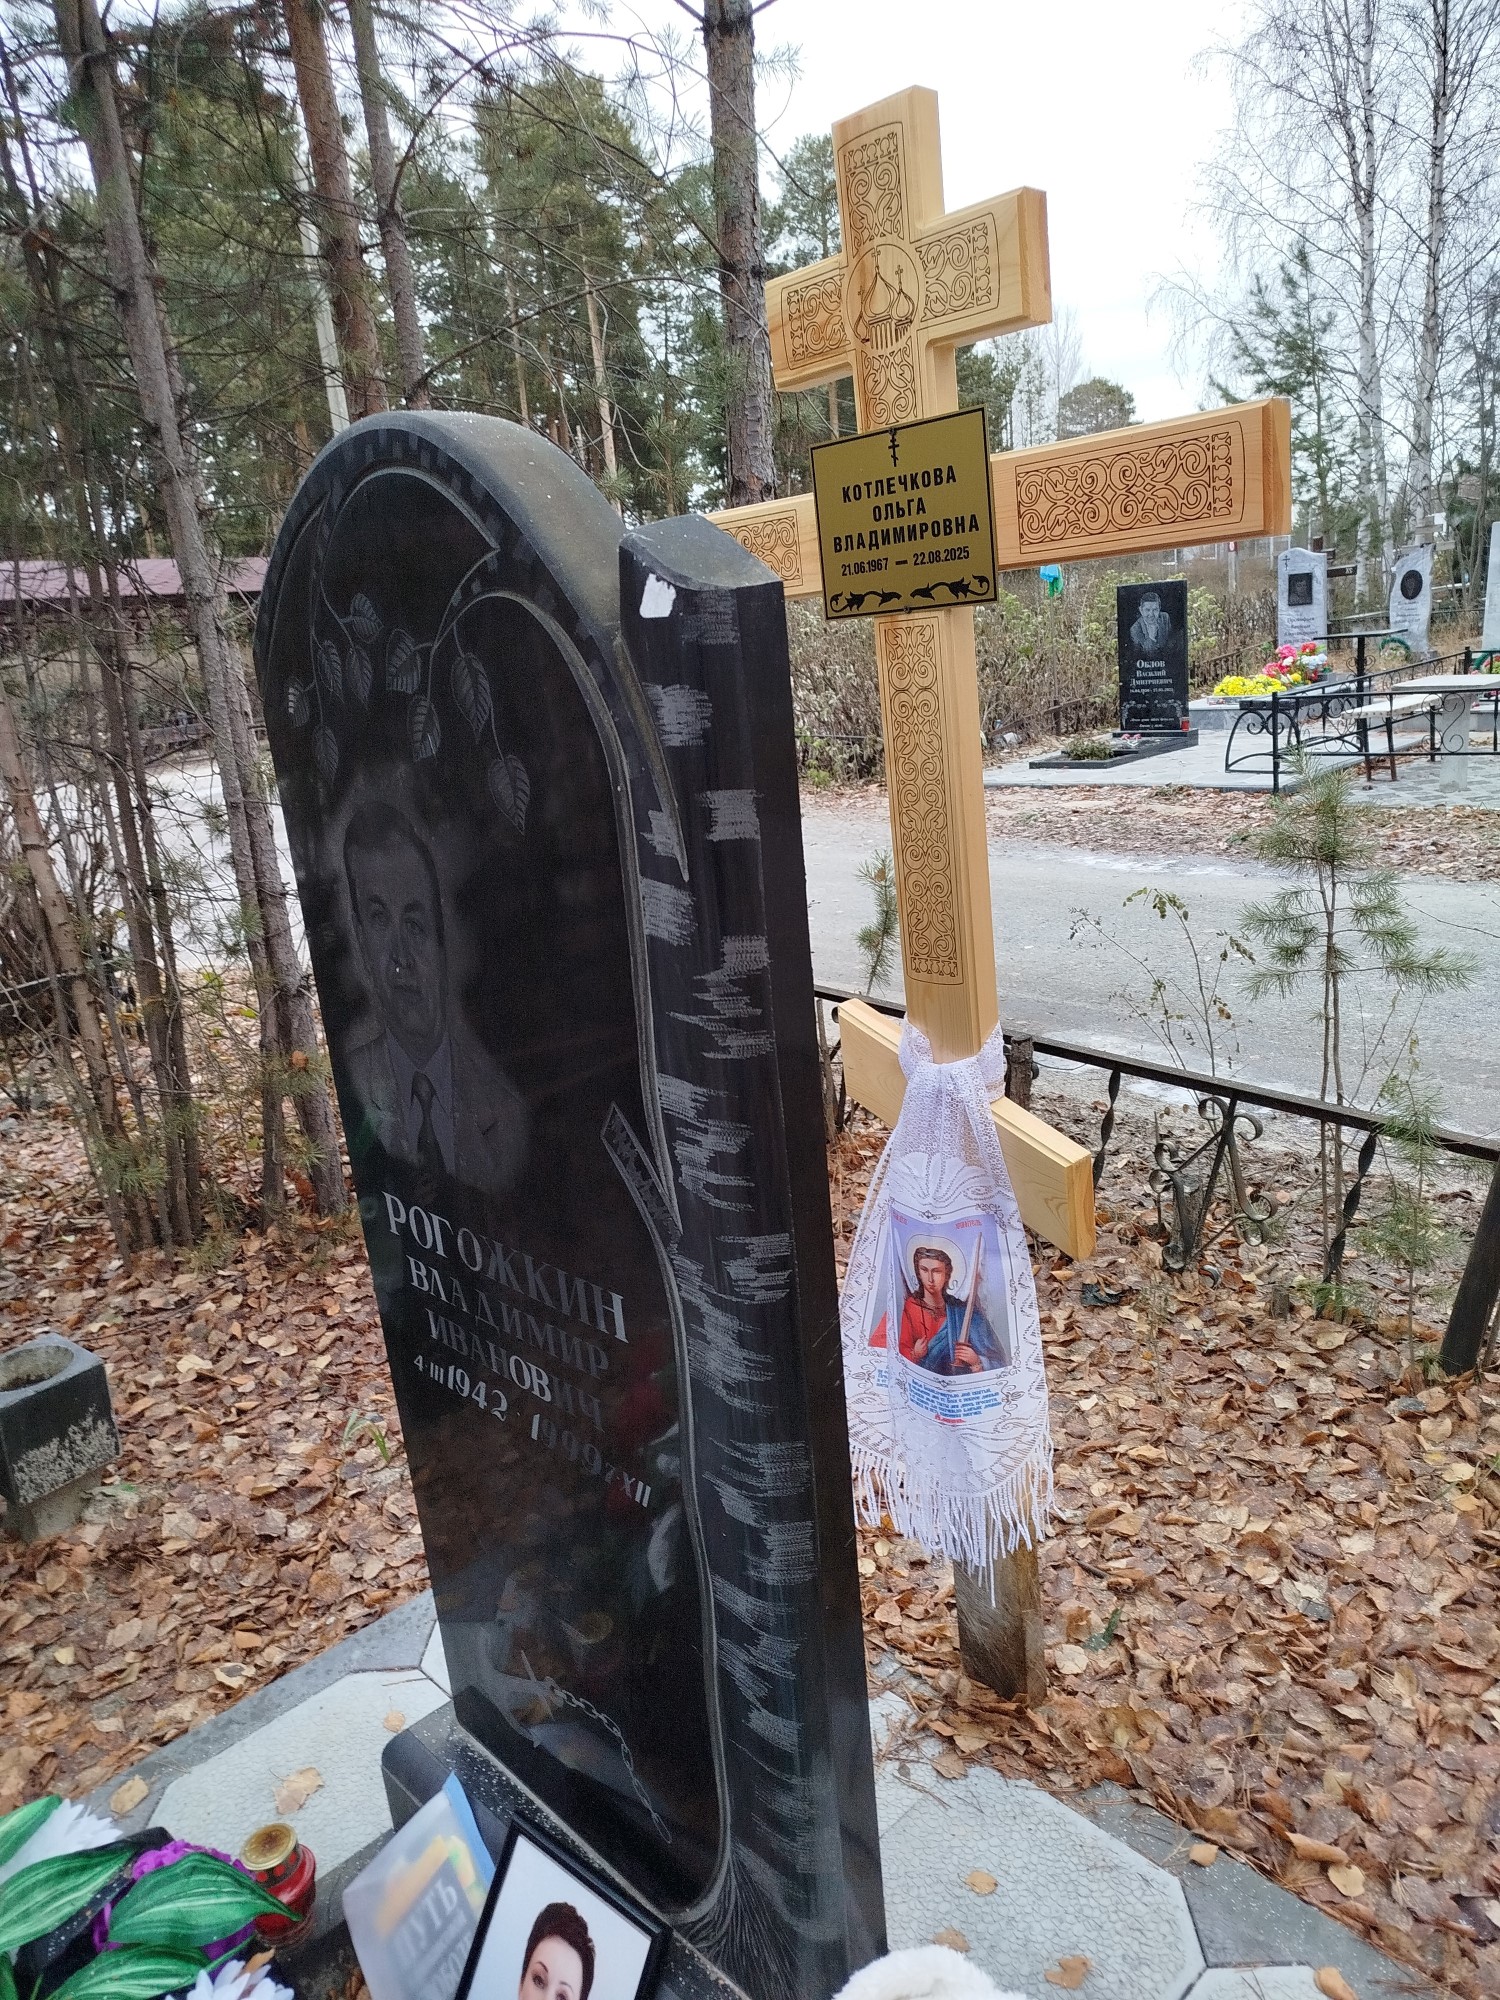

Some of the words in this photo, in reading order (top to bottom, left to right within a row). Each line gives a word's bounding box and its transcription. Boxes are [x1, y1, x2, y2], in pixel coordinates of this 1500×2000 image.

[842, 465, 957, 503] КОТЛЕЧКОВА
[872, 497, 926, 523] ОЛЬГА
[833, 513, 980, 554] ВЛАДИМИРОВНА
[841, 557, 889, 577] 21.06.1967
[913, 546, 970, 566] 22.08.2025
[381, 1190, 630, 1344] РОГОЖКИН
[405, 1254, 610, 1381] ВЛАДИМИР
[425, 1307, 605, 1434] ИВАНОВИЧ
